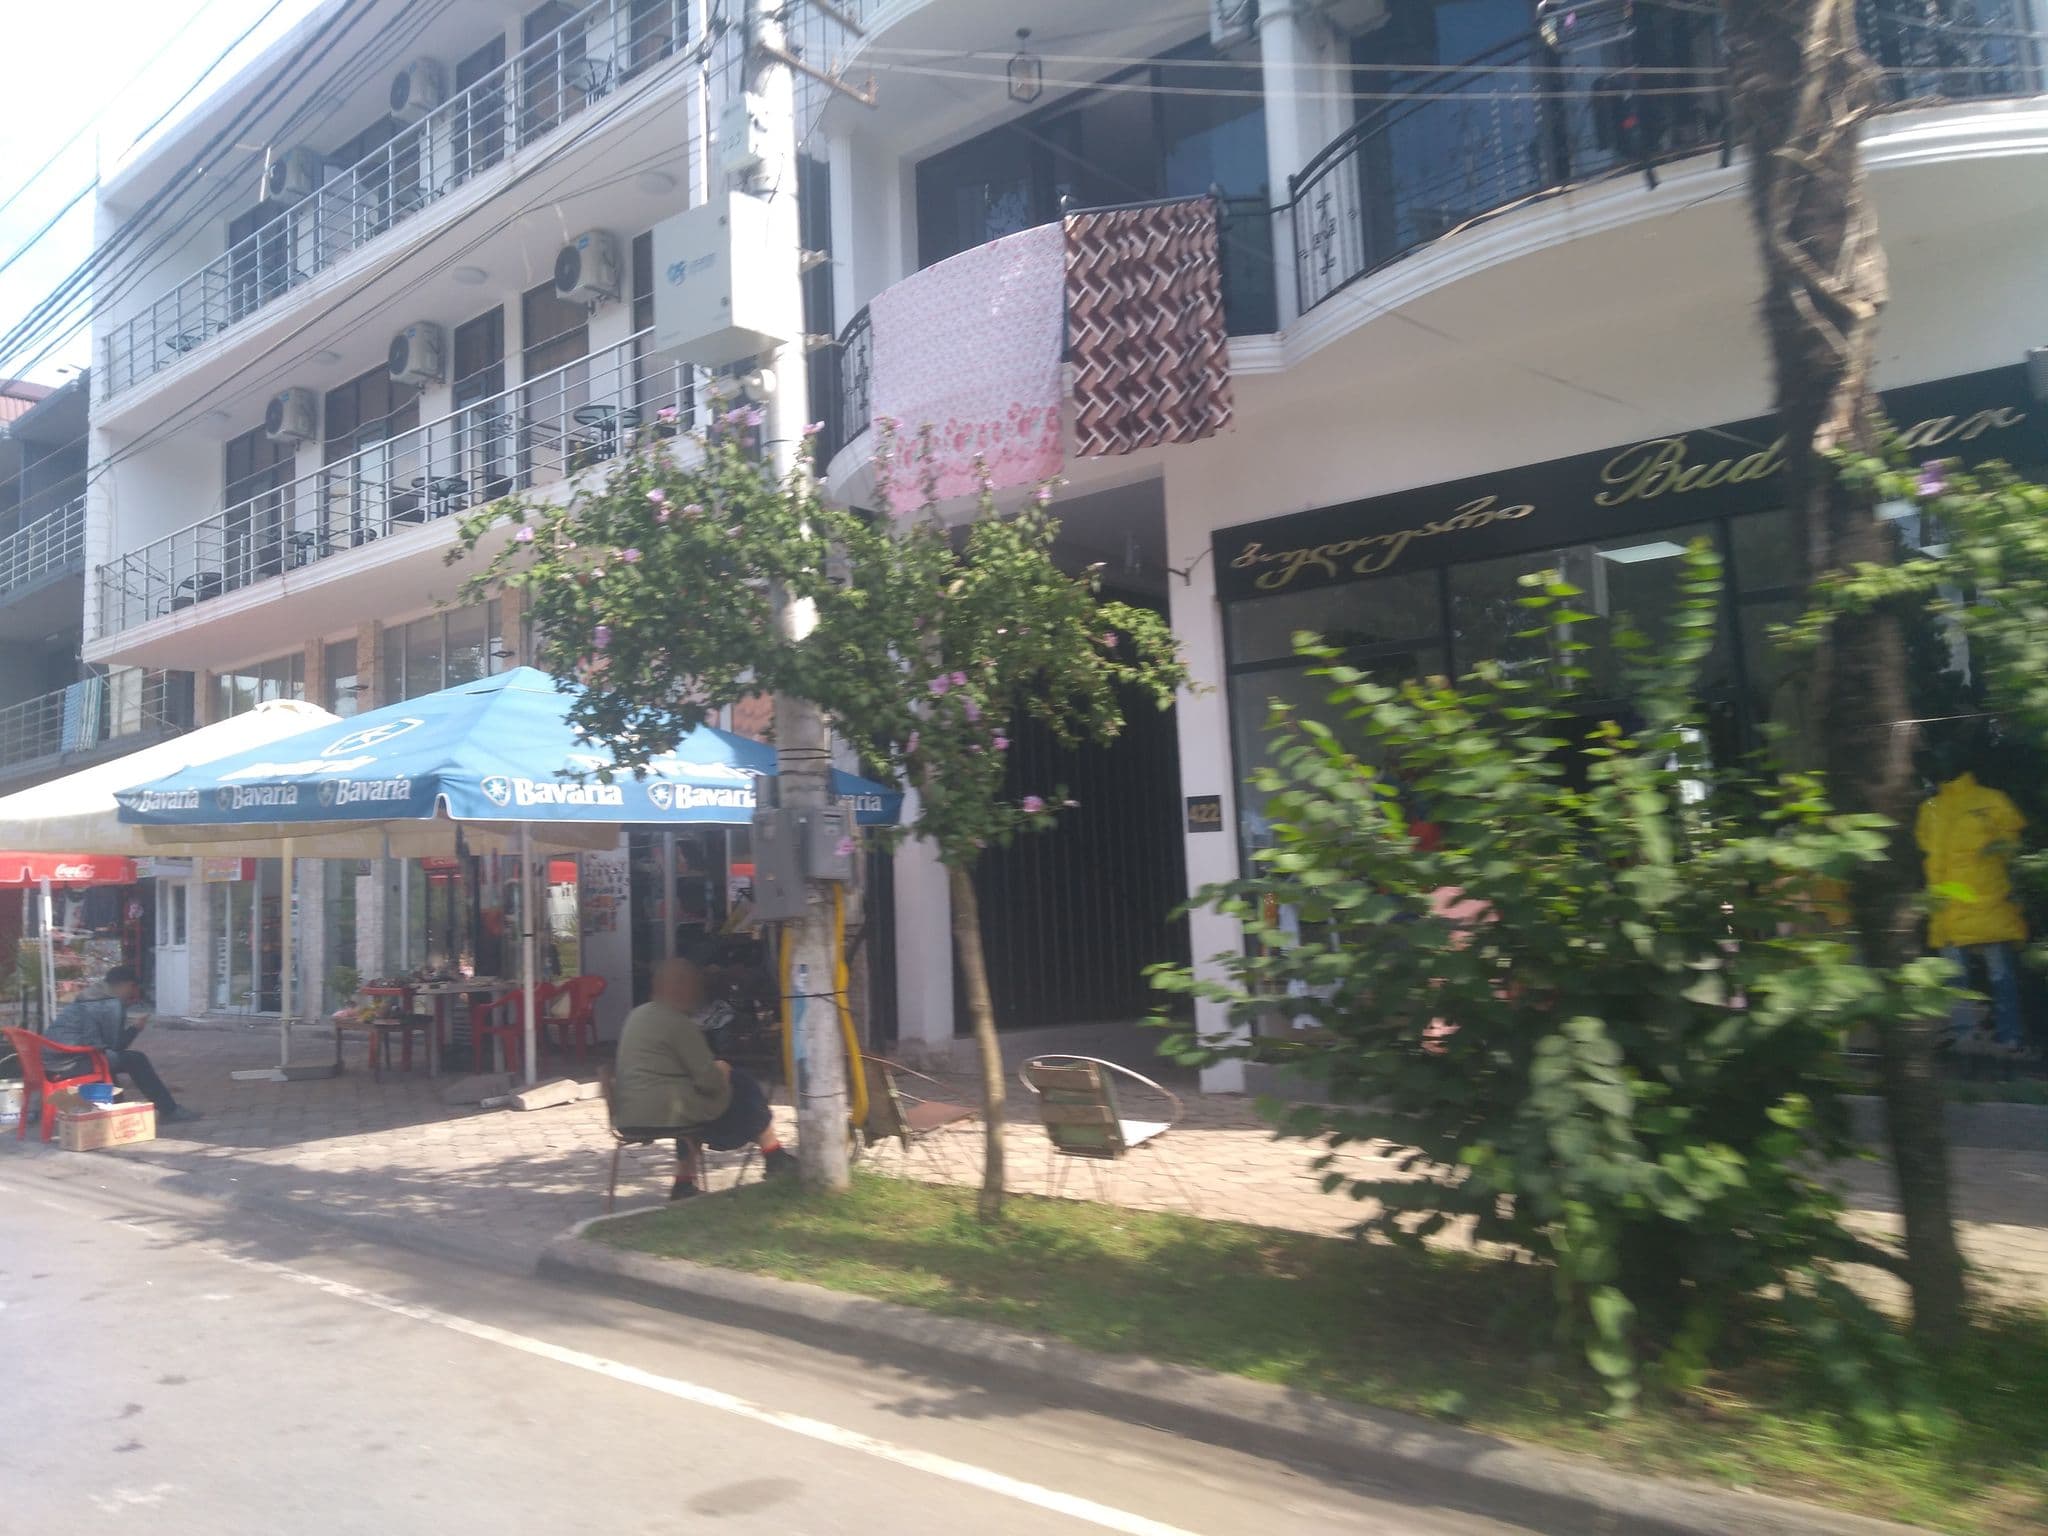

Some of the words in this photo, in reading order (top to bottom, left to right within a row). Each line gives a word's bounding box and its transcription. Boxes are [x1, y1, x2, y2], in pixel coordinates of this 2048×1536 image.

[1594, 407, 2027, 506] Budar
[137, 787, 200, 812] Bavaria
[231, 781, 298, 810] Bavaria
[335, 777, 411, 806] Bavaria
[514, 777, 624, 806] Bavaria
[674, 783, 757, 809] Bavari
